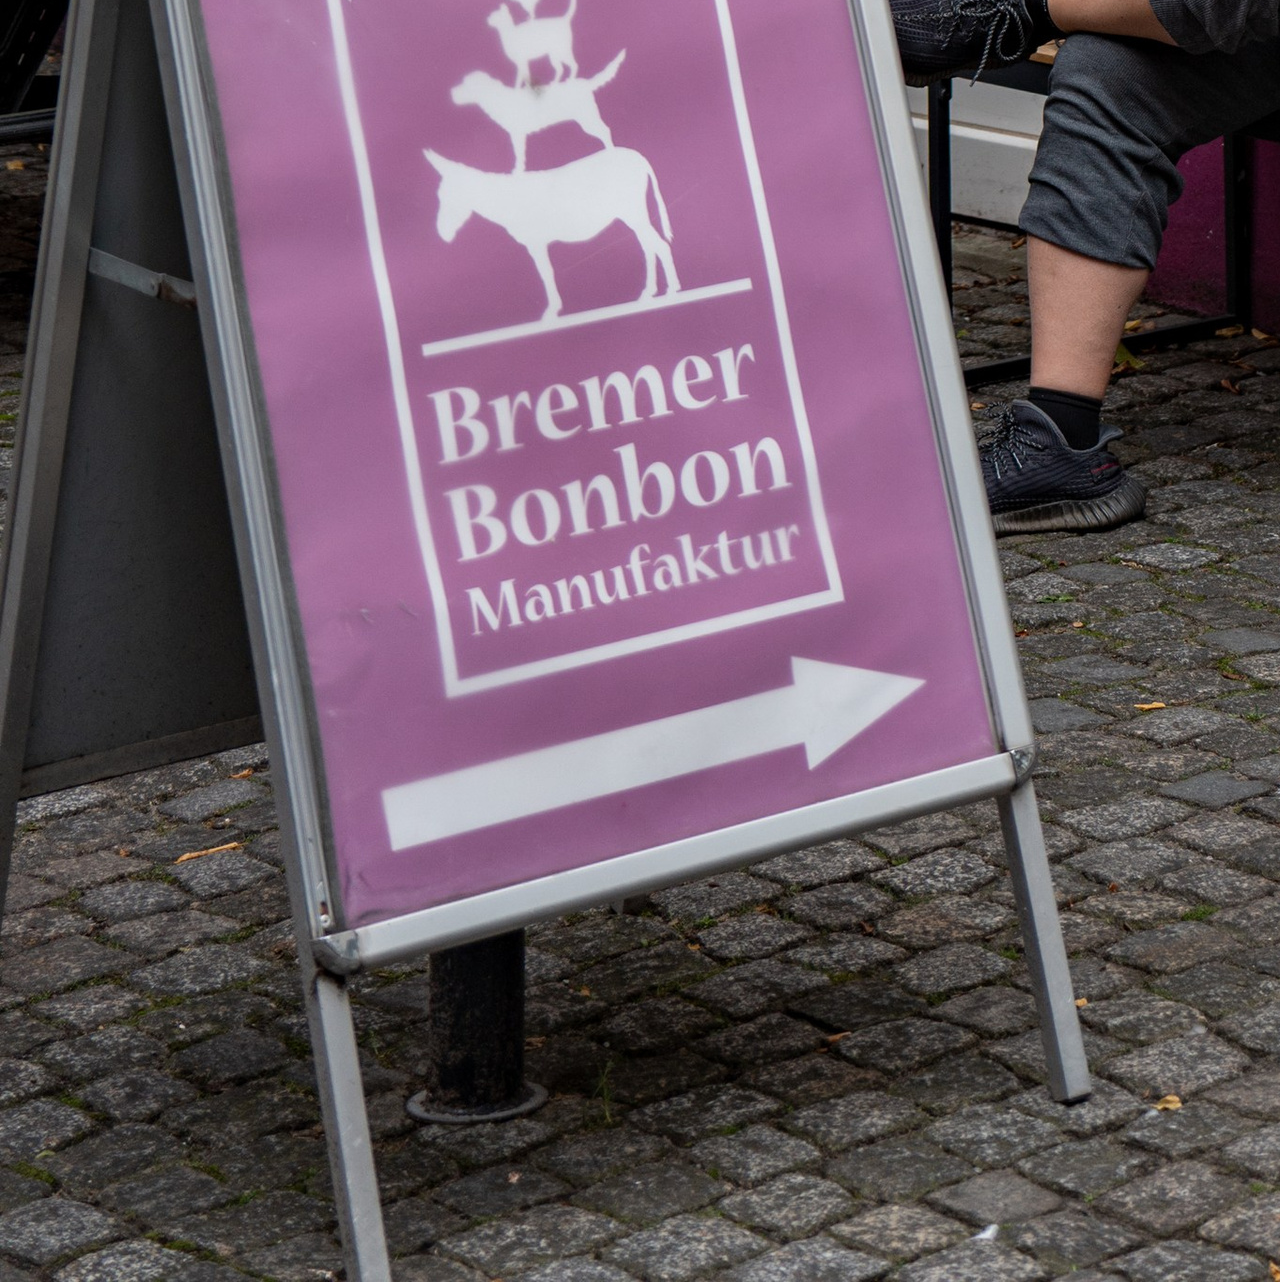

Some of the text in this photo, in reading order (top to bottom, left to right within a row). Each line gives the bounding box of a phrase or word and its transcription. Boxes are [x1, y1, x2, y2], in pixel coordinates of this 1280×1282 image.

[427, 343, 756, 465] Bremer
[443, 436, 792, 563] Bonbon
[464, 523, 800, 636] Manufaktur
